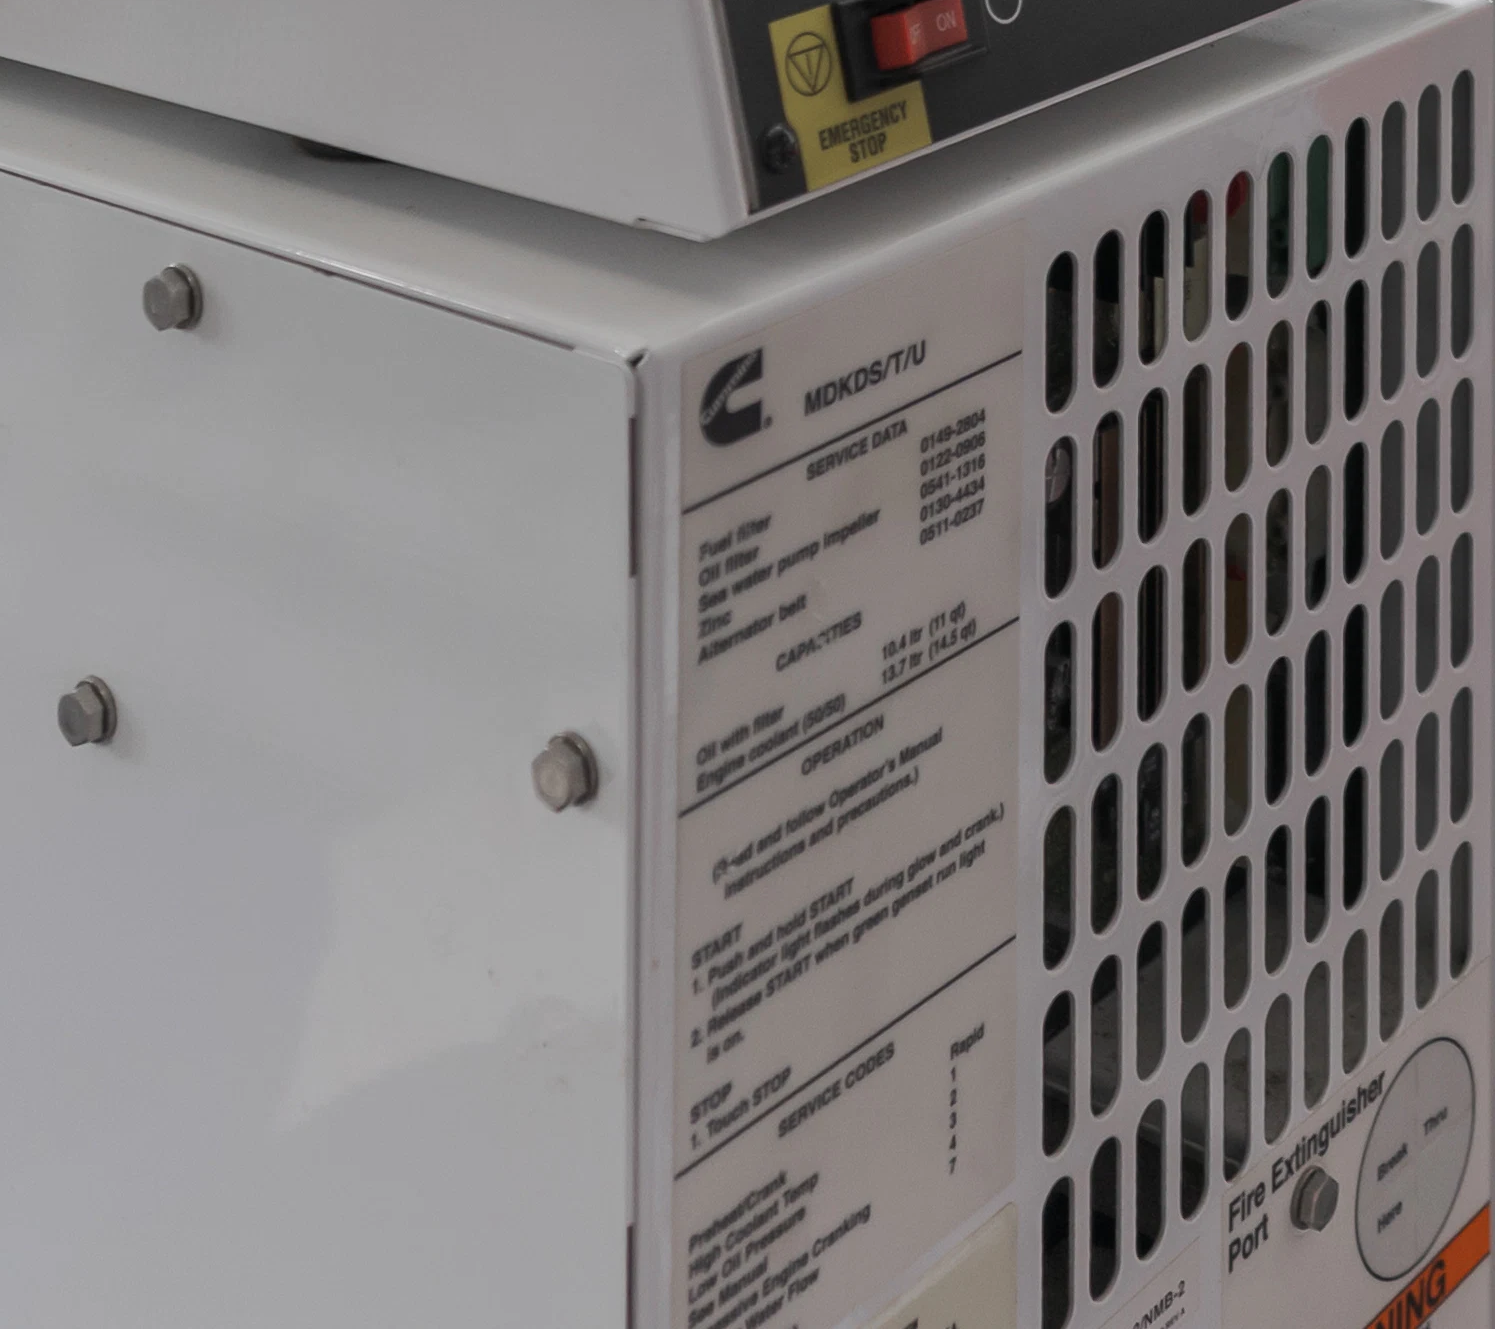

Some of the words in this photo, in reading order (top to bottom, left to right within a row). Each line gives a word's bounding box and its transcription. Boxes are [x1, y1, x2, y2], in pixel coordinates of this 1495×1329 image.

[935, 10, 958, 32] ON
[818, 100, 909, 151] EMERGENCY
[849, 132, 888, 164] STOP
[804, 339, 927, 418] MDKDS/T/U
[806, 437, 869, 481] SERVICE
[871, 418, 909, 451] DATA
[920, 475, 986, 522] 0130-4434
[920, 498, 986, 545] 0511-0237
[699, 531, 733, 563] Fuel
[736, 514, 772, 544] filter
[699, 588, 727, 613] Sea
[732, 564, 774, 595] water
[777, 540, 820, 577] pump
[823, 508, 881, 550] impeller
[699, 565, 720, 587] Oil
[698, 612, 776, 665] Alternator
[778, 593, 807, 621] belt
[696, 742, 717, 766] Oil
[720, 725, 751, 753] with
[696, 753, 745, 793] Engine
[748, 721, 800, 762] coolant
[801, 713, 885, 776] OPERATION
[757, 824, 782, 854] and
[785, 802, 825, 837] follow
[828, 757, 897, 809] Operator's
[899, 726, 944, 767] Manual
[809, 818, 834, 848] and
[836, 764, 920, 834] precautions.)
[781, 929, 811, 962] light
[814, 900, 861, 939] flashes
[864, 870, 905, 908] during
[907, 849, 937, 883] glow
[939, 829, 963, 859] and
[691, 921, 743, 971] START
[707, 989, 763, 1037] Release
[766, 954, 812, 999] START
[815, 933, 850, 966] when
[852, 907, 890, 945] green
[892, 875, 934, 918] genset
[936, 861, 957, 885] run
[959, 838, 987, 871] light
[708, 950, 744, 986] Push
[747, 930, 774, 961] and
[776, 910, 806, 942] hold
[809, 876, 855, 920] START
[950, 1021, 986, 1061] Rapid
[690, 1081, 733, 1126] STOP
[707, 1099, 750, 1138] Touch
[752, 1065, 792, 1108] STOP
[778, 1078, 842, 1138] SERVICE
[845, 1041, 896, 1091] CODES
[1227, 1177, 1267, 1235] Fire
[1270, 1069, 1387, 1196] Extinguisher
[1422, 1106, 1449, 1138] Thru
[1375, 1142, 1410, 1183] Break
[689, 1246, 722, 1280] High
[725, 1201, 780, 1253] Coolant
[782, 1172, 821, 1209] Temp
[1227, 1213, 1270, 1275] Port
[1375, 1200, 1404, 1235] Here
[688, 1272, 719, 1306] Low
[721, 1253, 743, 1281] Oil
[744, 1206, 807, 1263] Pressure
[718, 1256, 769, 1309] Manual
[762, 1252, 810, 1300] Engine
[812, 1203, 873, 1259] Cranking
[787, 1268, 821, 1304] Flow
